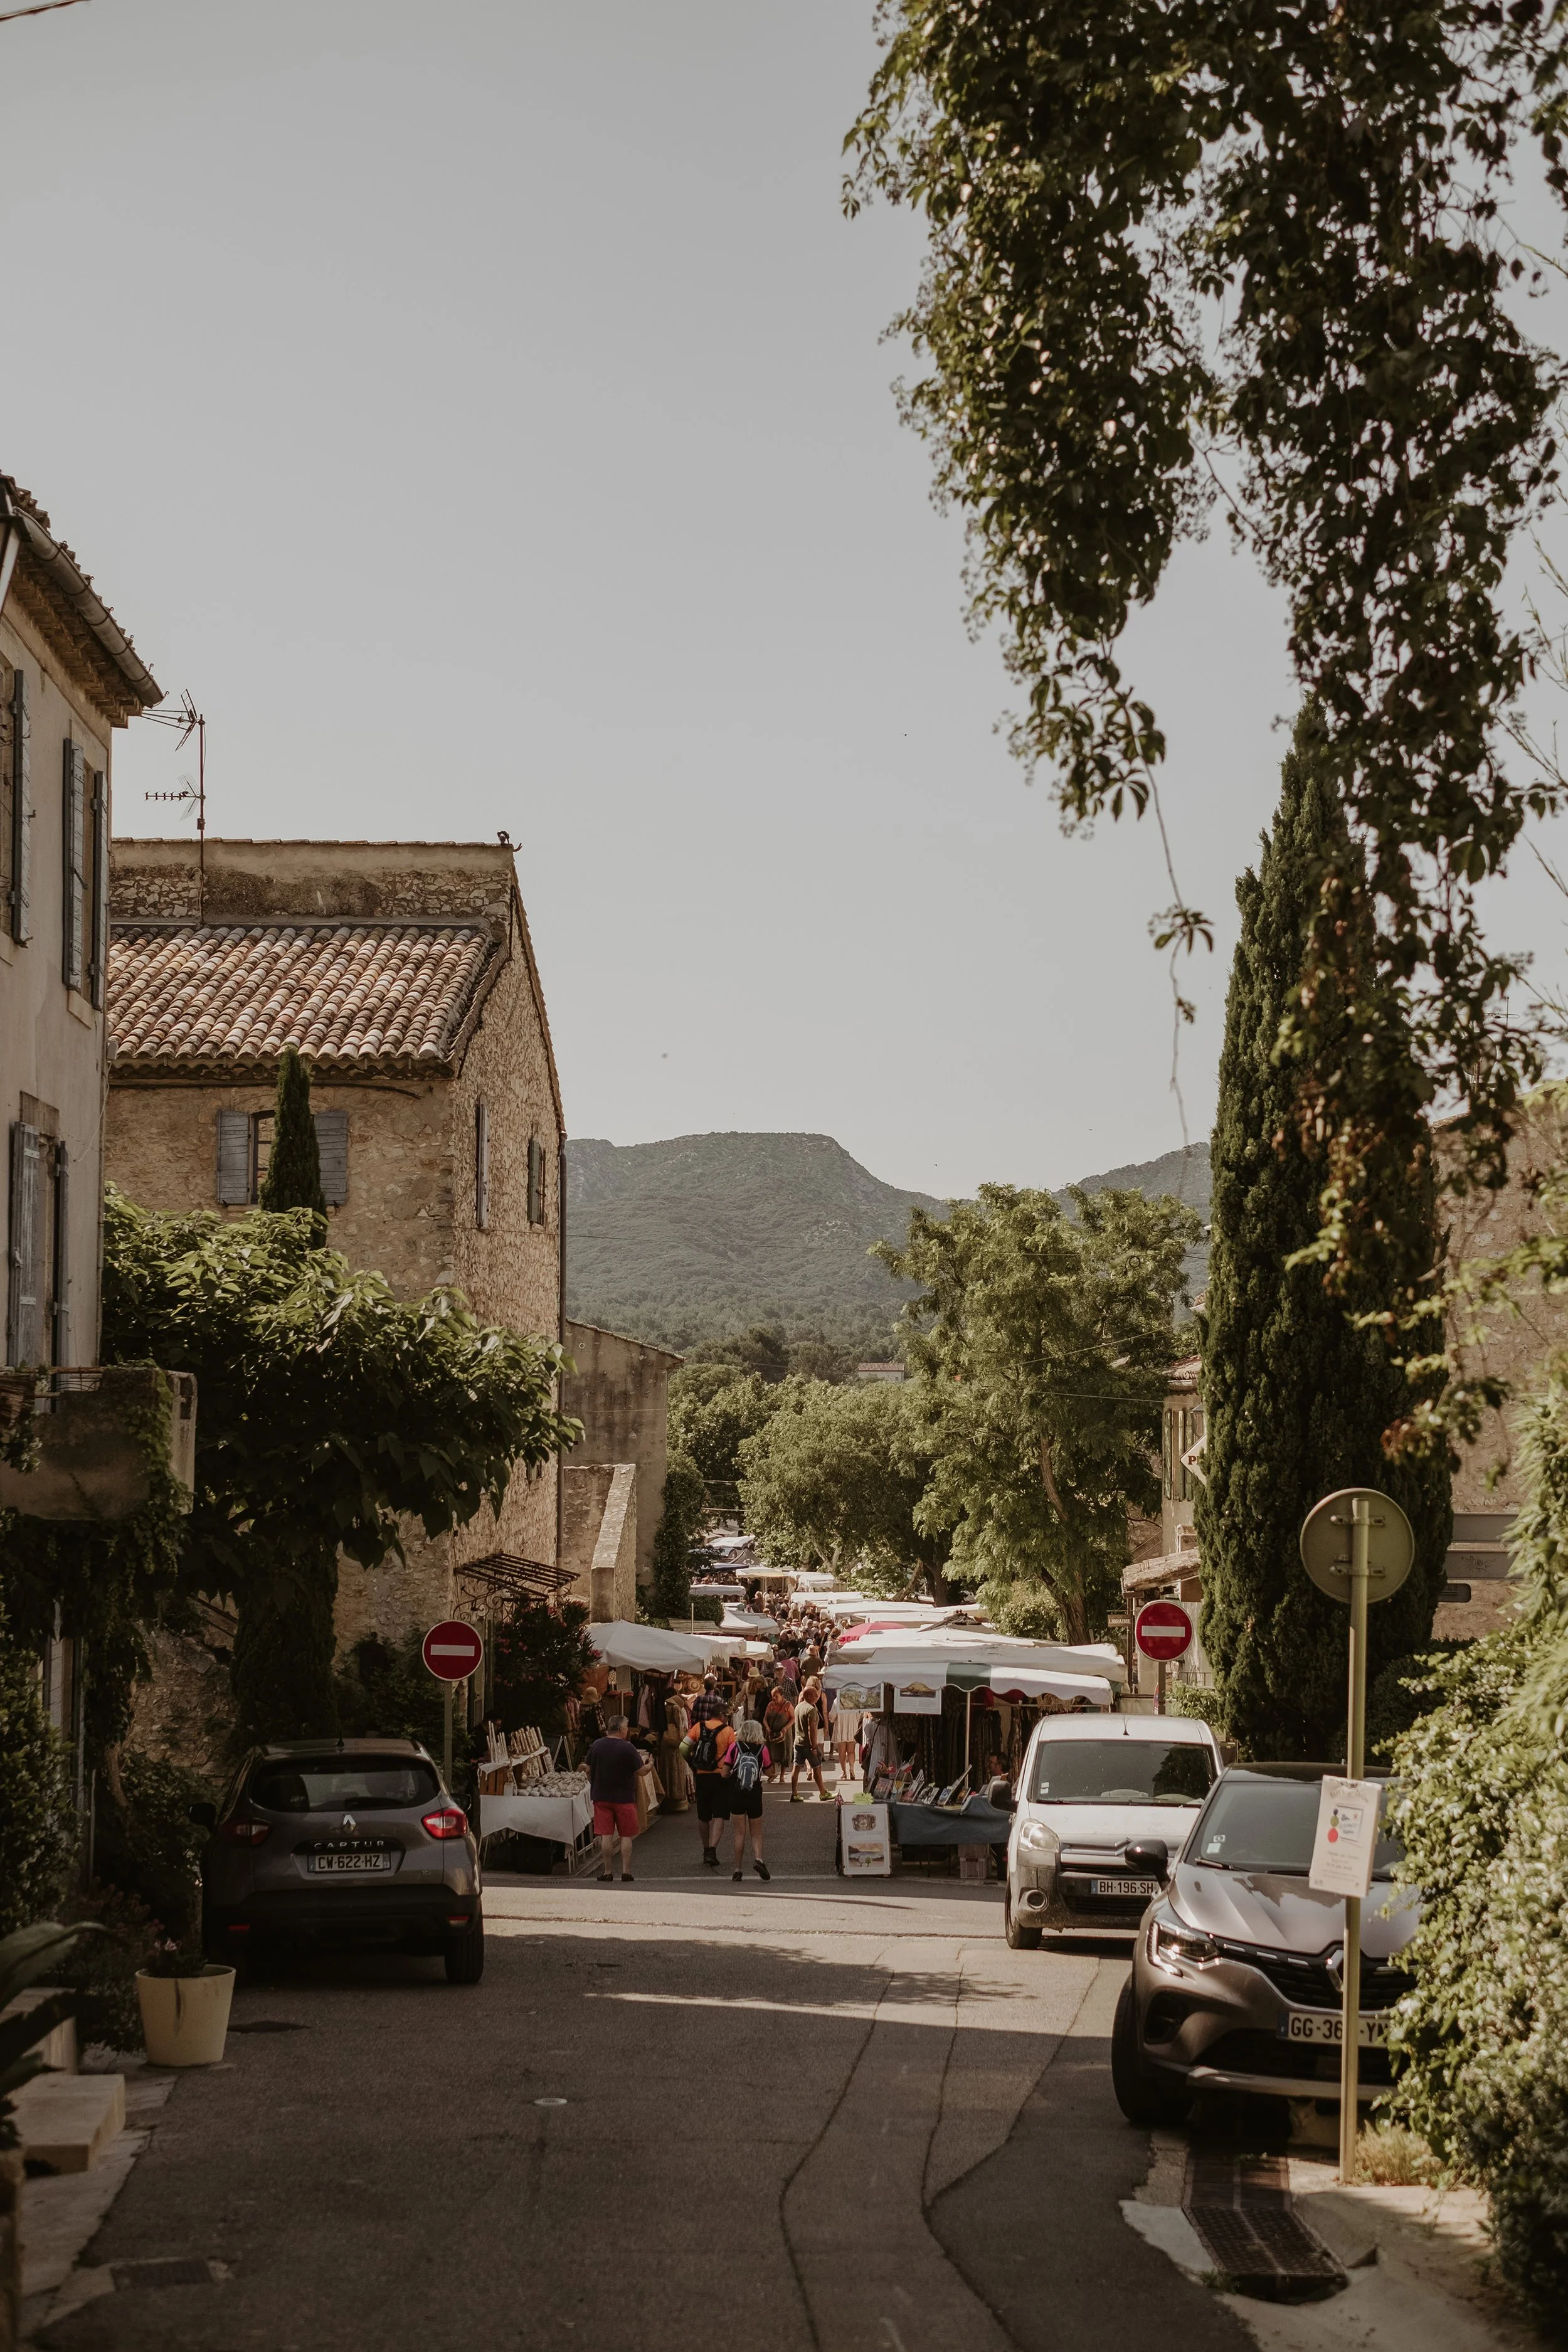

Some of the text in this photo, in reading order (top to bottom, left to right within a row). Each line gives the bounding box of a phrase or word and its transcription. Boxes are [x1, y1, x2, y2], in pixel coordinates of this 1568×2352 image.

[314, 1840, 384, 1848] CAPTUR
[317, 1855, 381, 1870] CW-622-HZ
[1099, 1882, 1153, 1894] BH-196-SH
